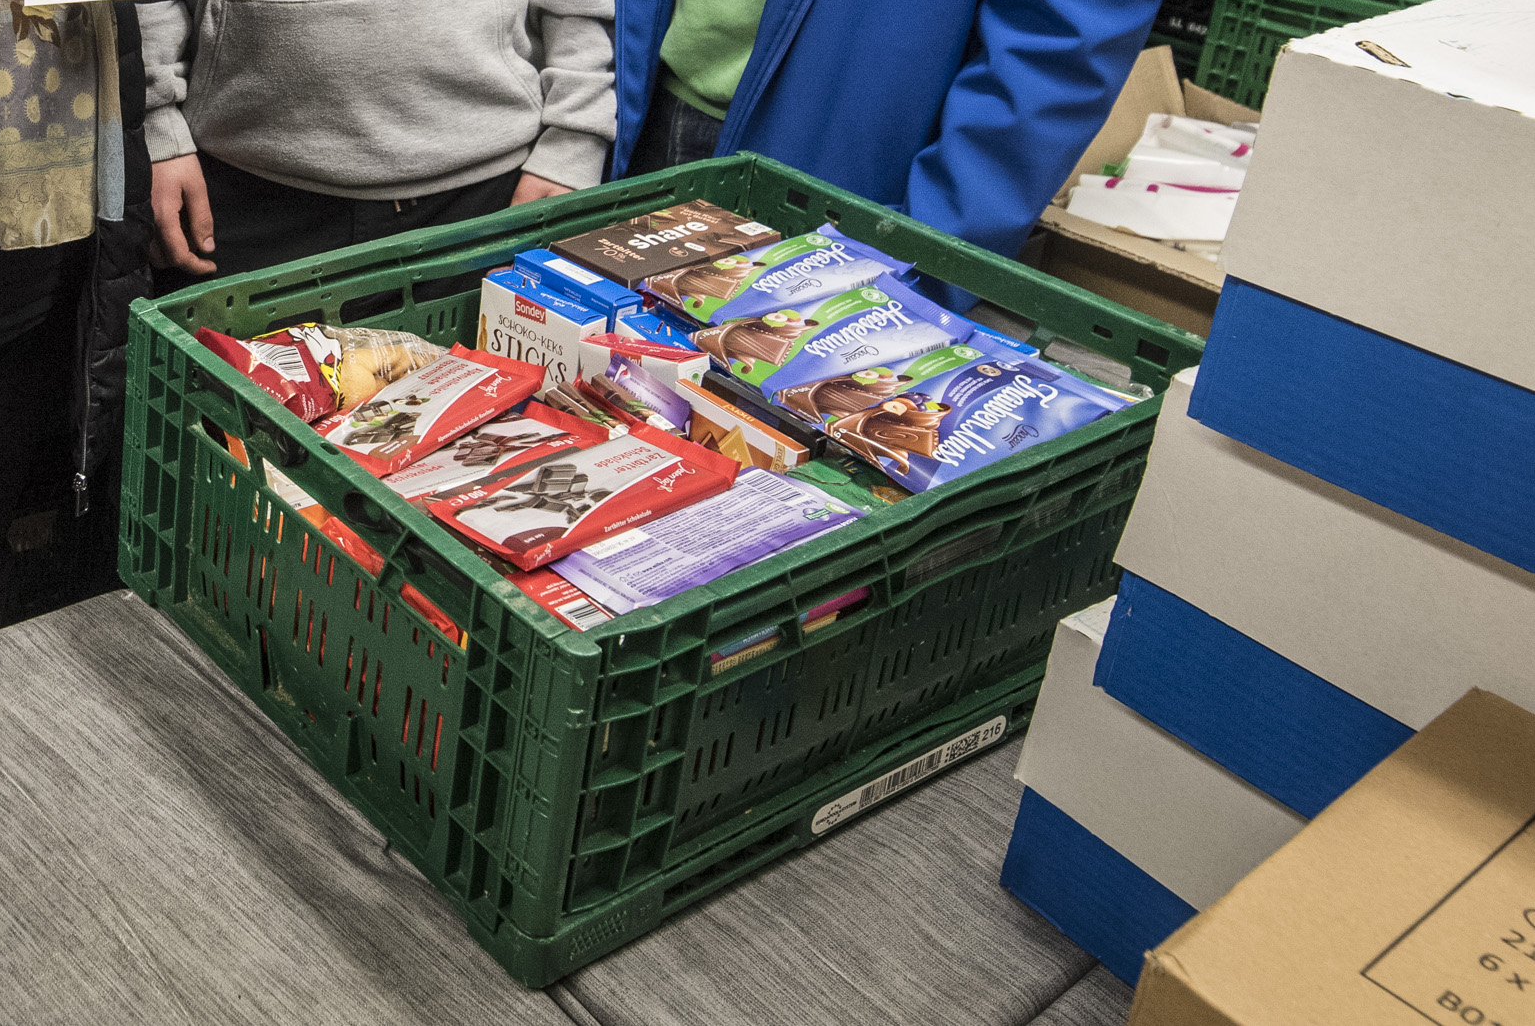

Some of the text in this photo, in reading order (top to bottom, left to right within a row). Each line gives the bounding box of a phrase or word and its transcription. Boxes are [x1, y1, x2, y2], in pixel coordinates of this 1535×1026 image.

[627, 221, 709, 250] share
[751, 242, 856, 294] Haselnuss
[516, 300, 546, 320] Sondey
[498, 315, 564, 356] SCHOKO-KEKS
[803, 300, 914, 358] Haselnuss
[491, 328, 567, 384] STICKS
[840, 344, 879, 365] Choceur
[547, 439, 566, 448] 100
[1000, 423, 1040, 452] Choceur
[594, 446, 652, 468] Schokolade
[615, 452, 666, 475] Zartbitter
[472, 490, 488, 499] 100
[604, 509, 652, 533] Zartbitter Schokolade
[982, 722, 1002, 741] 216
[1479, 954, 1505, 972] 6
[1436, 990, 1504, 1026] BO
